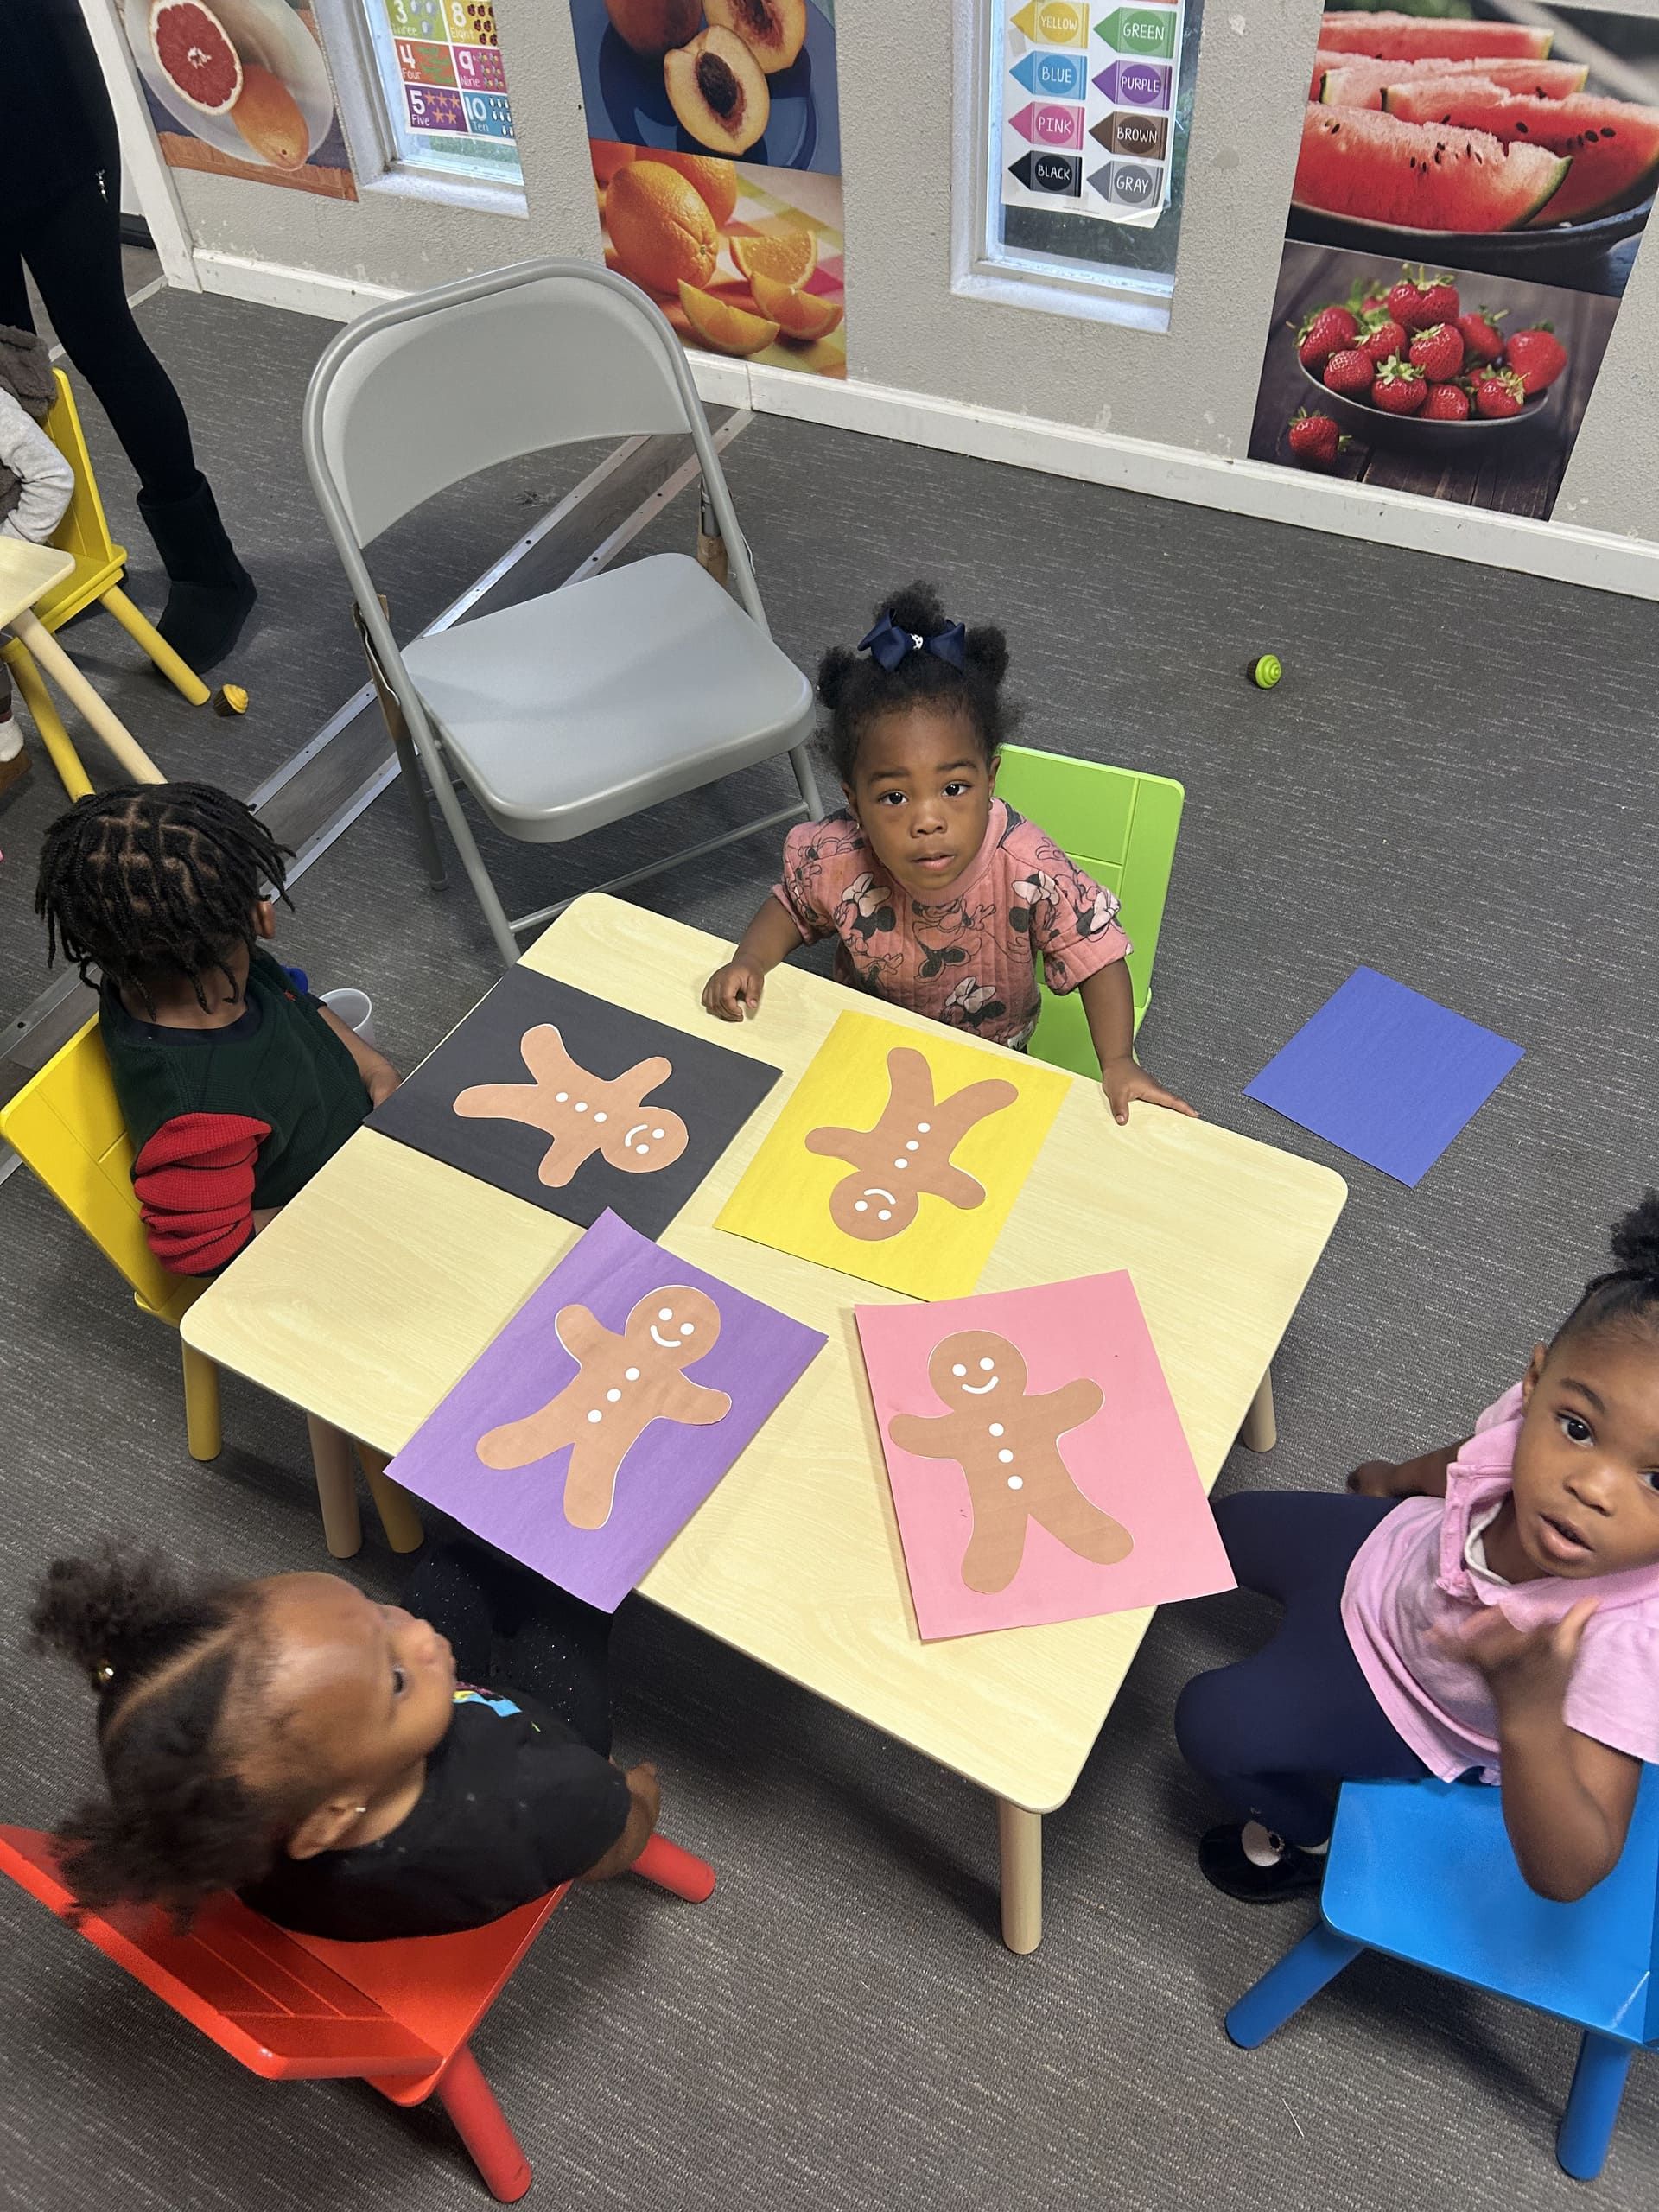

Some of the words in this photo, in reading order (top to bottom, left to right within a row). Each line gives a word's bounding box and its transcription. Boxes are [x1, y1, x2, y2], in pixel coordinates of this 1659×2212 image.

[394, 0, 408, 23] 3
[451, 2, 467, 28] 8
[1040, 16, 1077, 31] YELLOW
[1123, 22, 1166, 41] GREEN
[450, 27, 475, 41] Eight
[399, 44, 416, 68] 4
[459, 51, 475, 76] 9
[403, 68, 422, 79] Four
[461, 76, 480, 87] Nine
[1041, 67, 1072, 84] BLUE
[1121, 75, 1160, 93] PURPLE
[410, 90, 425, 114] 5
[465, 97, 486, 121] 10
[411, 114, 430, 126] Five
[474, 122, 489, 132] Ten
[1038, 117, 1072, 134] PINK
[1116, 127, 1158, 143] BROWN
[1038, 164, 1071, 181] BLACK
[1116, 177, 1149, 194] GRAY
